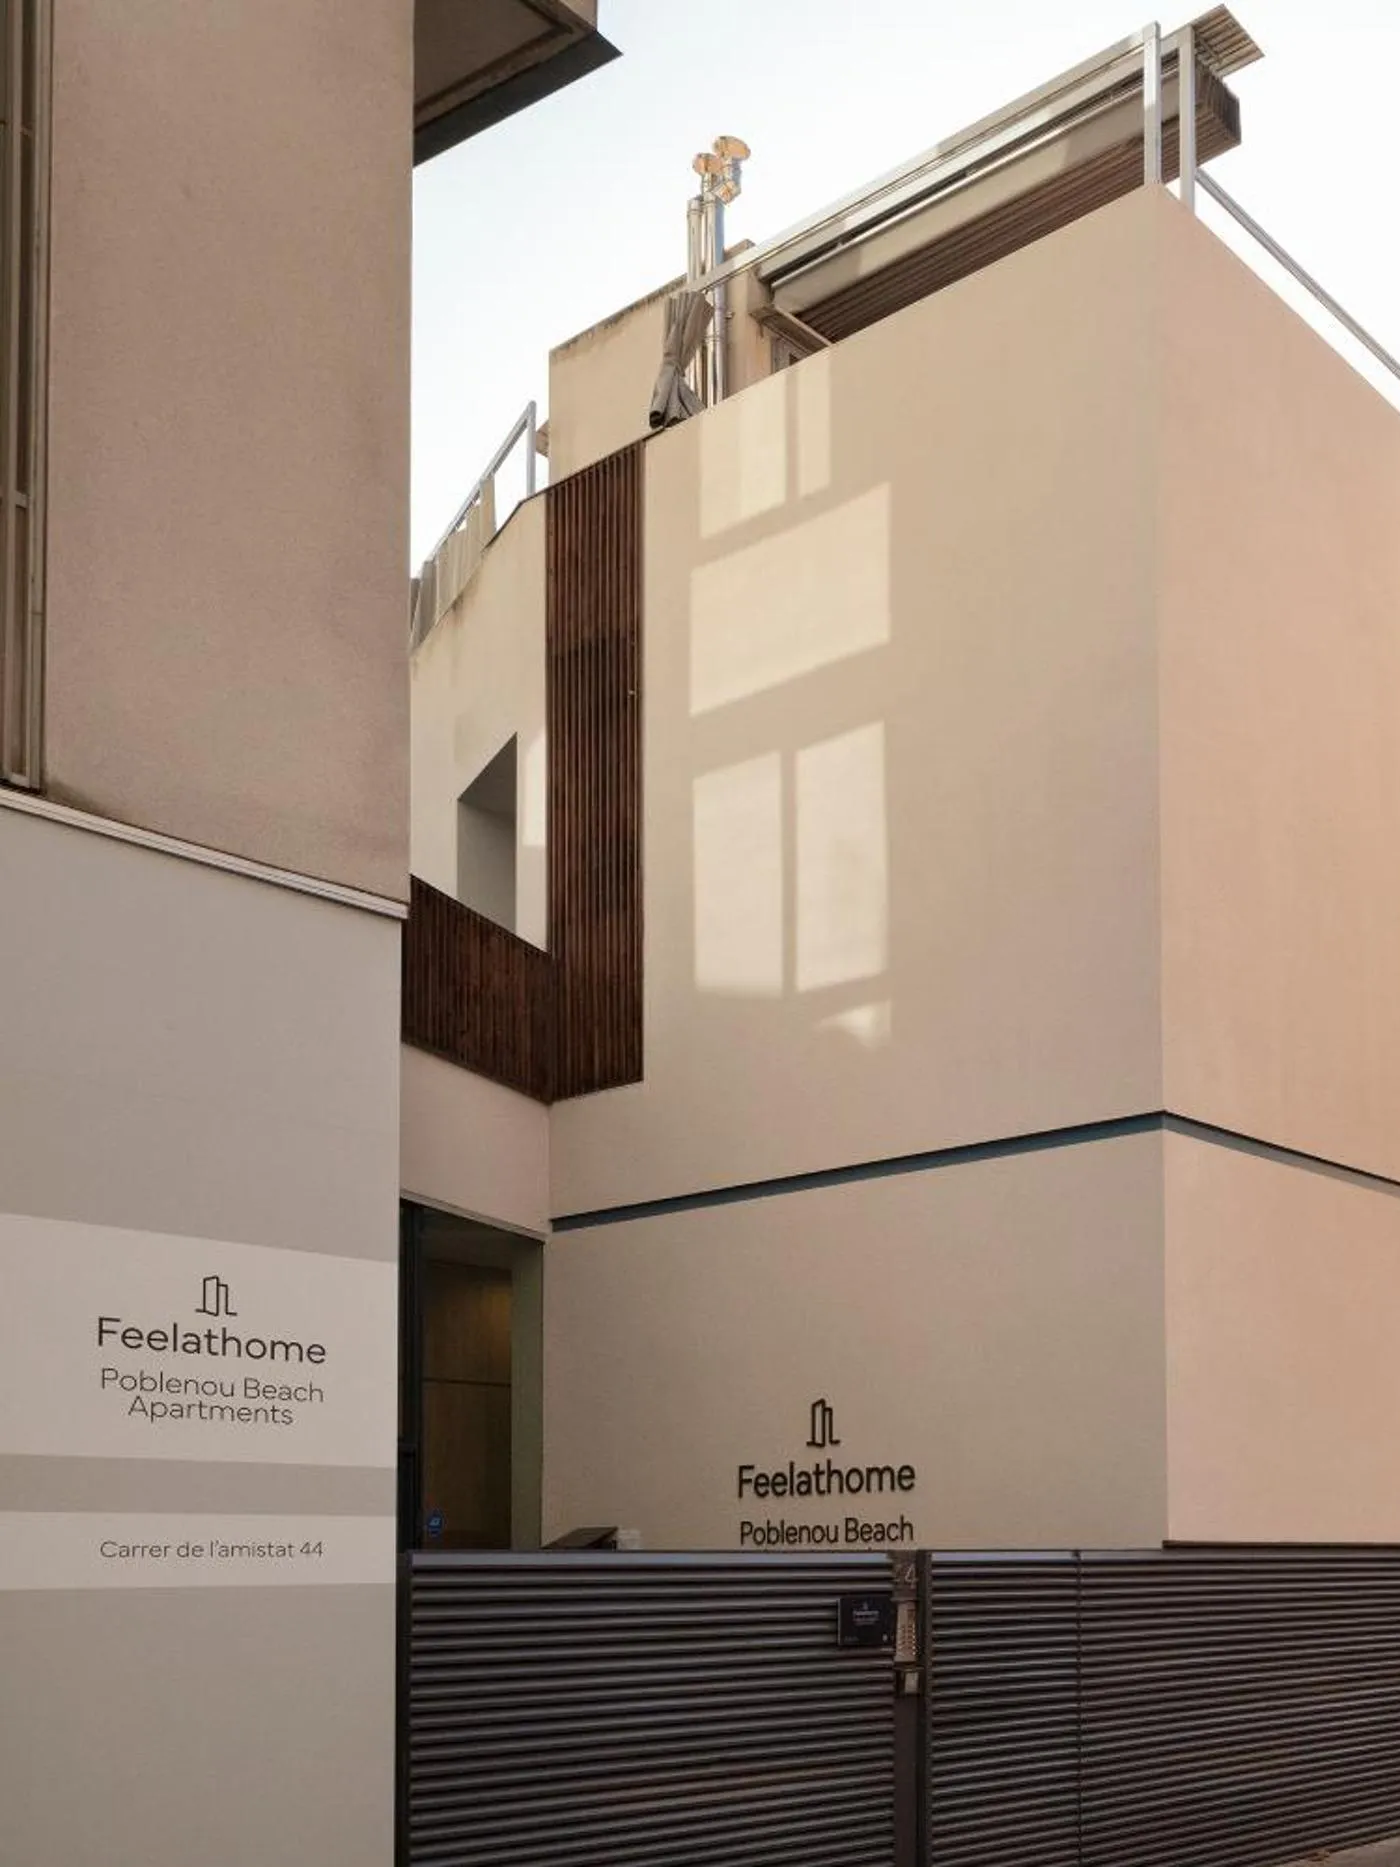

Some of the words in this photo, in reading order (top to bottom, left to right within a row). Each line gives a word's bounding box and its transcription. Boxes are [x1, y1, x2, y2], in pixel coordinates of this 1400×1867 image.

[97, 1316, 327, 1365] Feelathome
[101, 1367, 235, 1398] Poblenou
[243, 1377, 324, 1403] Beach
[127, 1395, 294, 1426] Apartments
[737, 1458, 916, 1499] Feelathome
[739, 1519, 839, 1546] Poblenou
[844, 1514, 914, 1544] Beach
[99, 1540, 171, 1559] Carrer
[176, 1541, 205, 1559] de
[299, 1541, 324, 1559] 44
